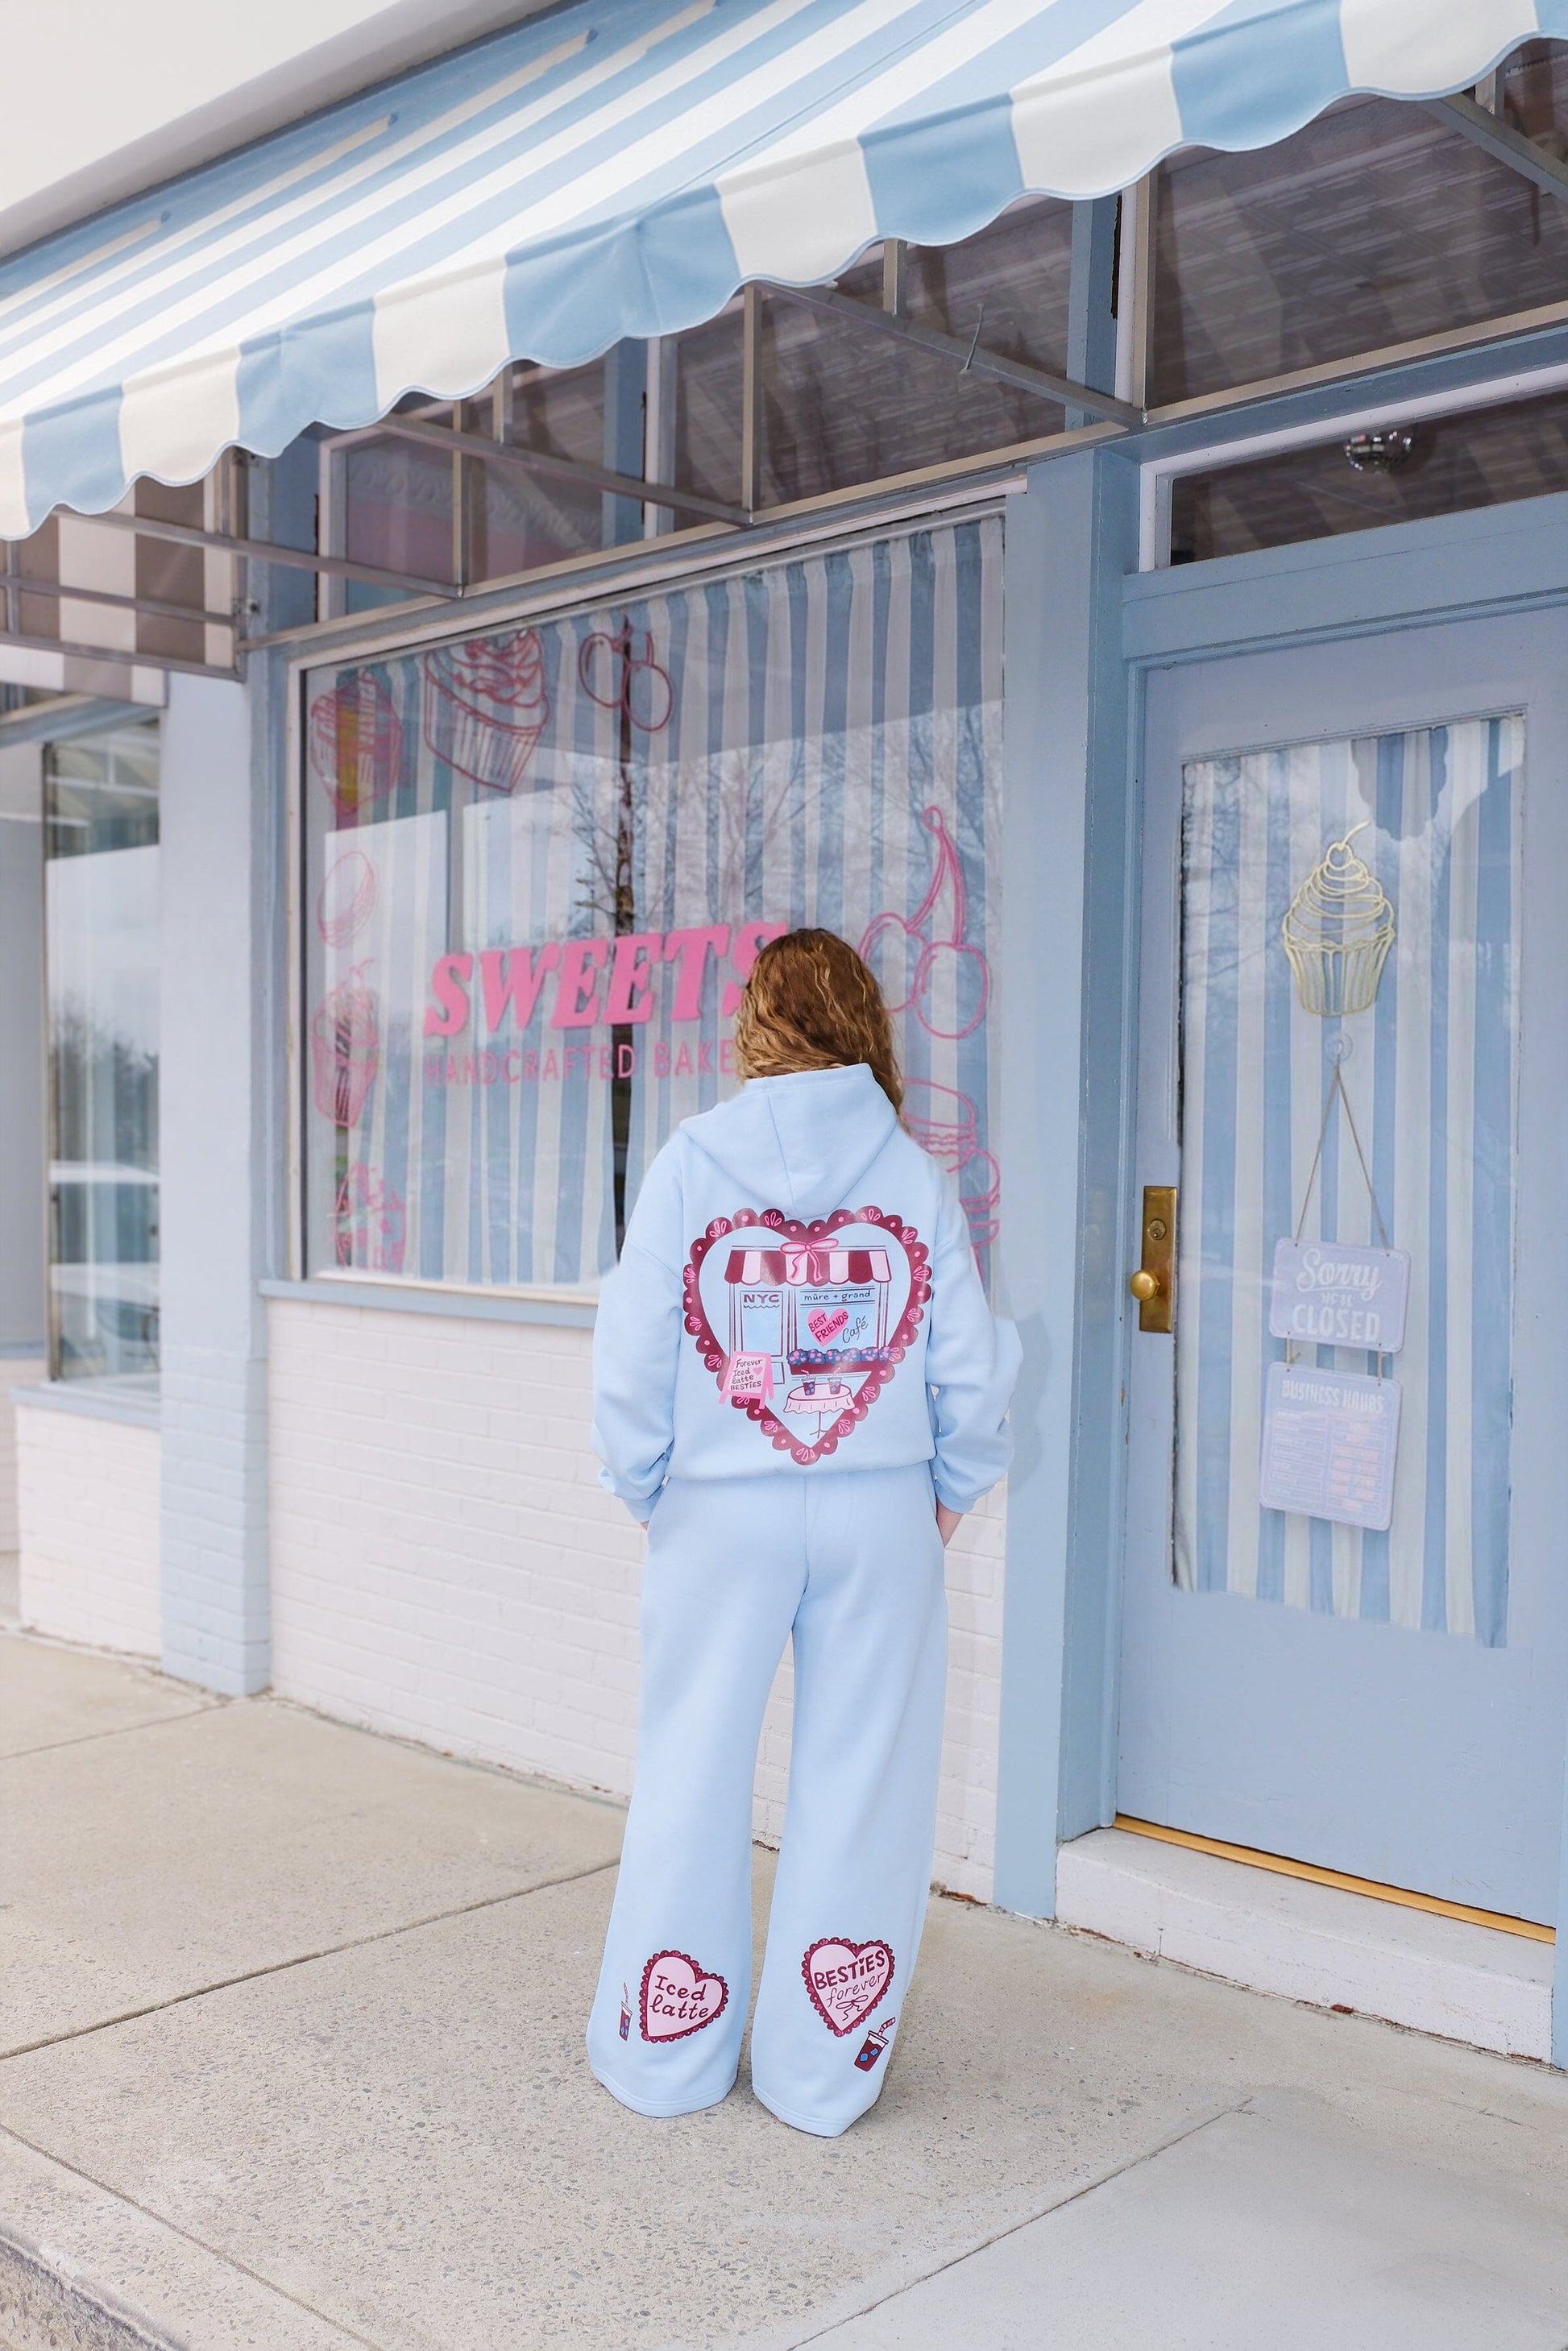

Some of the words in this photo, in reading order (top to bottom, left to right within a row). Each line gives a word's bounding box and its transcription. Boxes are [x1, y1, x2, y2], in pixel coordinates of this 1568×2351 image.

[422, 921, 786, 1036] SWEETS
[424, 1044, 635, 1086] HANDCRAFTED
[1296, 1248, 1382, 1301] Sorry
[744, 1293, 780, 1304] NYC
[841, 1289, 870, 1302] grand
[808, 1312, 827, 1333] BEST
[815, 1311, 848, 1342] FRIENDS
[842, 1315, 869, 1344] Café
[1292, 1304, 1380, 1342] CLOSED
[733, 1367, 750, 1377] Iced
[736, 1358, 762, 1369] Forever
[732, 1375, 754, 1385] latte
[1281, 1379, 1341, 1408] BUSINESS
[1342, 1388, 1386, 1414] HOURS
[654, 1974, 706, 2001] Iced
[825, 1971, 886, 2009] forever
[649, 1996, 710, 2021] latte
